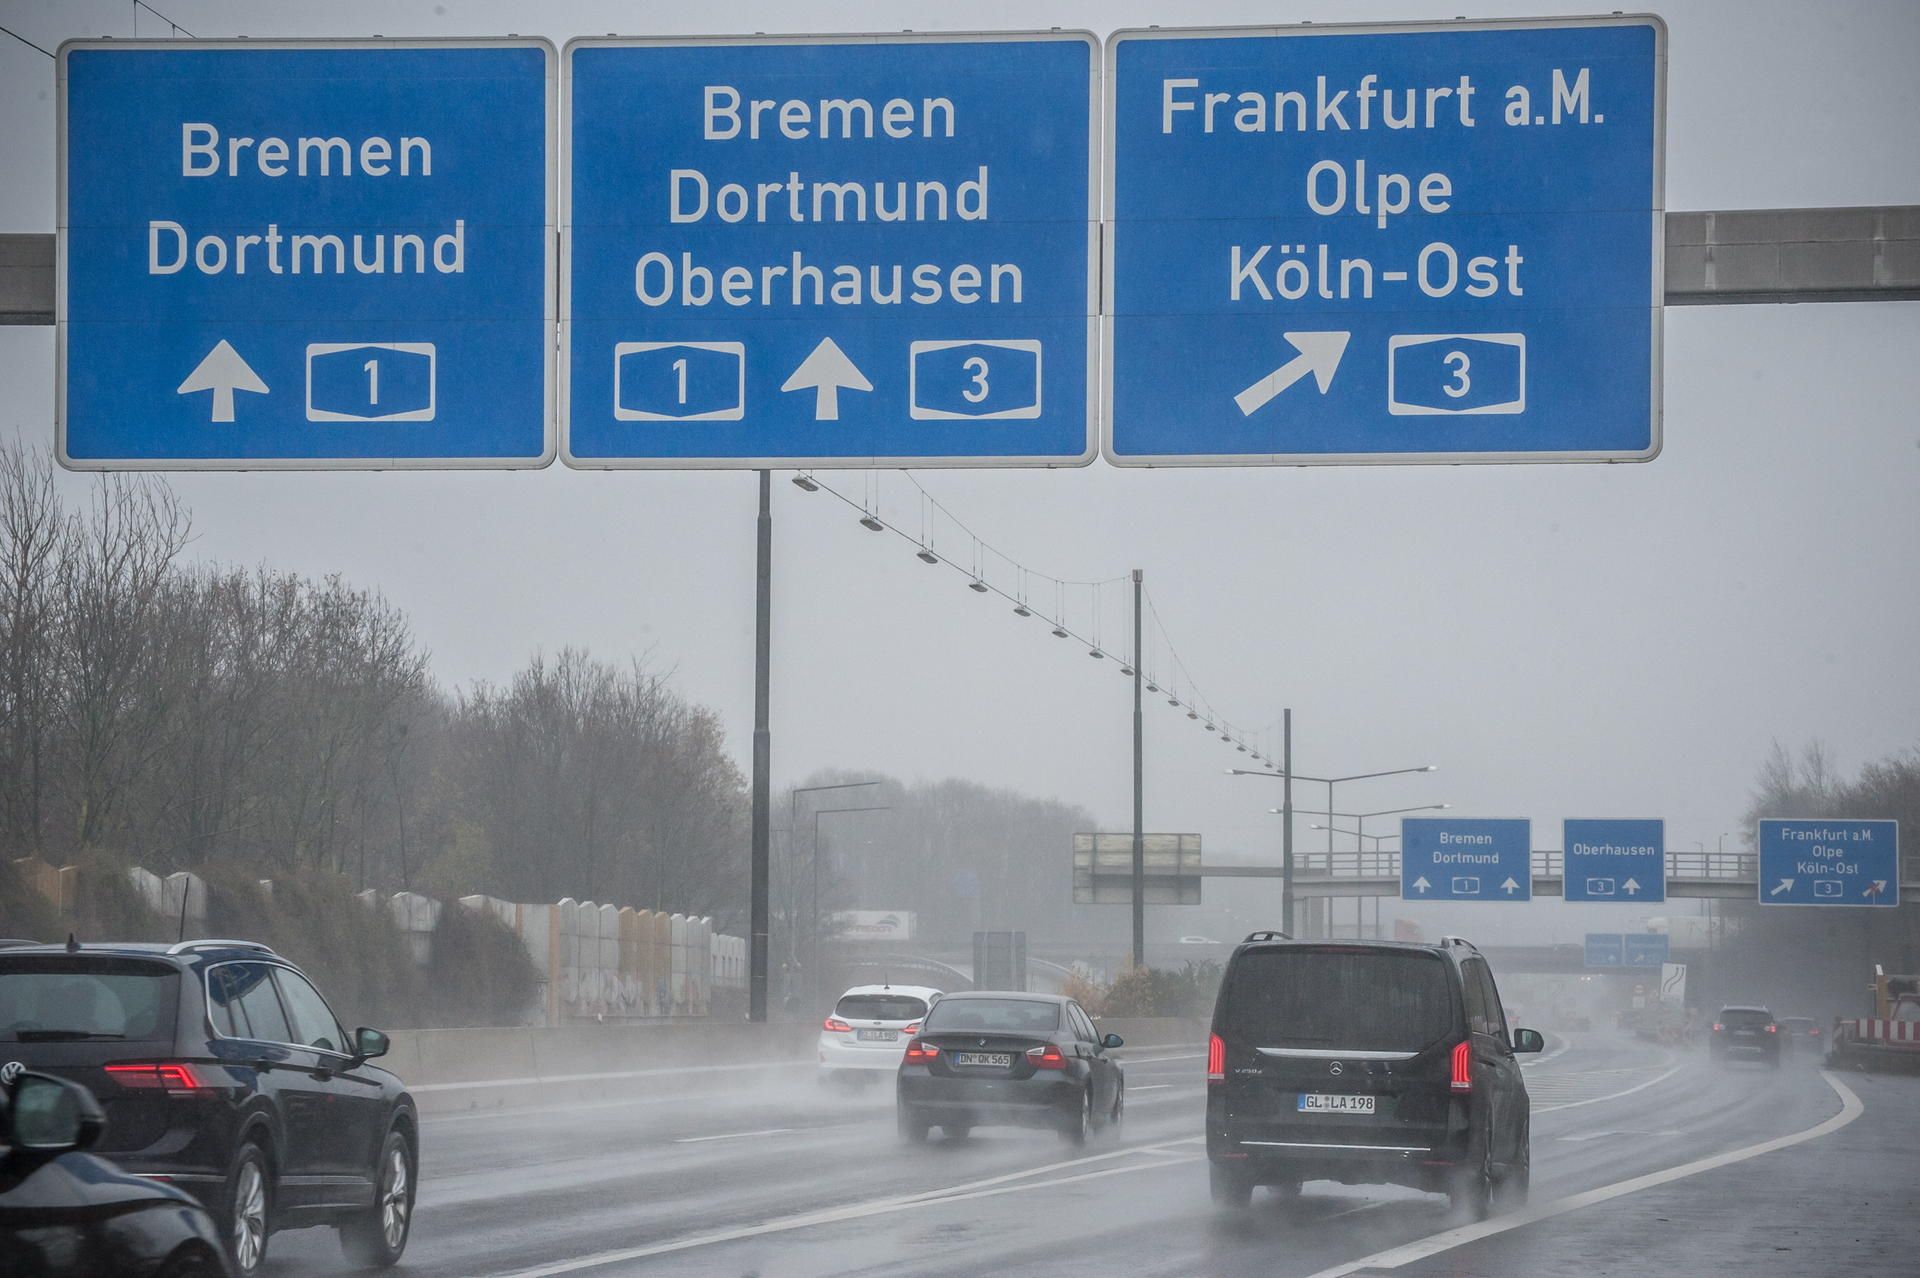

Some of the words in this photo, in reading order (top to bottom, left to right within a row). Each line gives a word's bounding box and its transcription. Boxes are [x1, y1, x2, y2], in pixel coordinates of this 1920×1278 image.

[703, 85, 955, 140] Bremen
[1162, 74, 1475, 135] Frankfurt
[1504, 68, 1605, 126] a.M.
[182, 123, 432, 178] Bremen
[670, 165, 988, 223] Dortmund
[1306, 159, 1452, 229] Olpe
[148, 219, 465, 275] Dortmund
[635, 252, 1022, 307] Oberhausen
[1230, 242, 1524, 301] Köln-Ost
[364, 360, 378, 405] 1
[672, 359, 687, 404] 1
[962, 356, 989, 403] 3
[1443, 351, 1471, 398] 3
[1439, 832, 1492, 844] Bremen
[1573, 843, 1655, 856] Oberhausen
[1781, 828, 1848, 841] Frankfurt
[1812, 845, 1843, 860] Olpe
[1432, 851, 1499, 864] Dortmund
[1796, 861, 1859, 875] Köln-Ost
[1596, 880, 1605, 893] 3
[1824, 882, 1833, 894] 3
[960, 1053, 973, 1063] DN
[991, 1055, 1009, 1065] 565
[1306, 1095, 1322, 1108] GL
[1331, 1096, 1347, 1109] LA
[1350, 1097, 1374, 1110] 198
